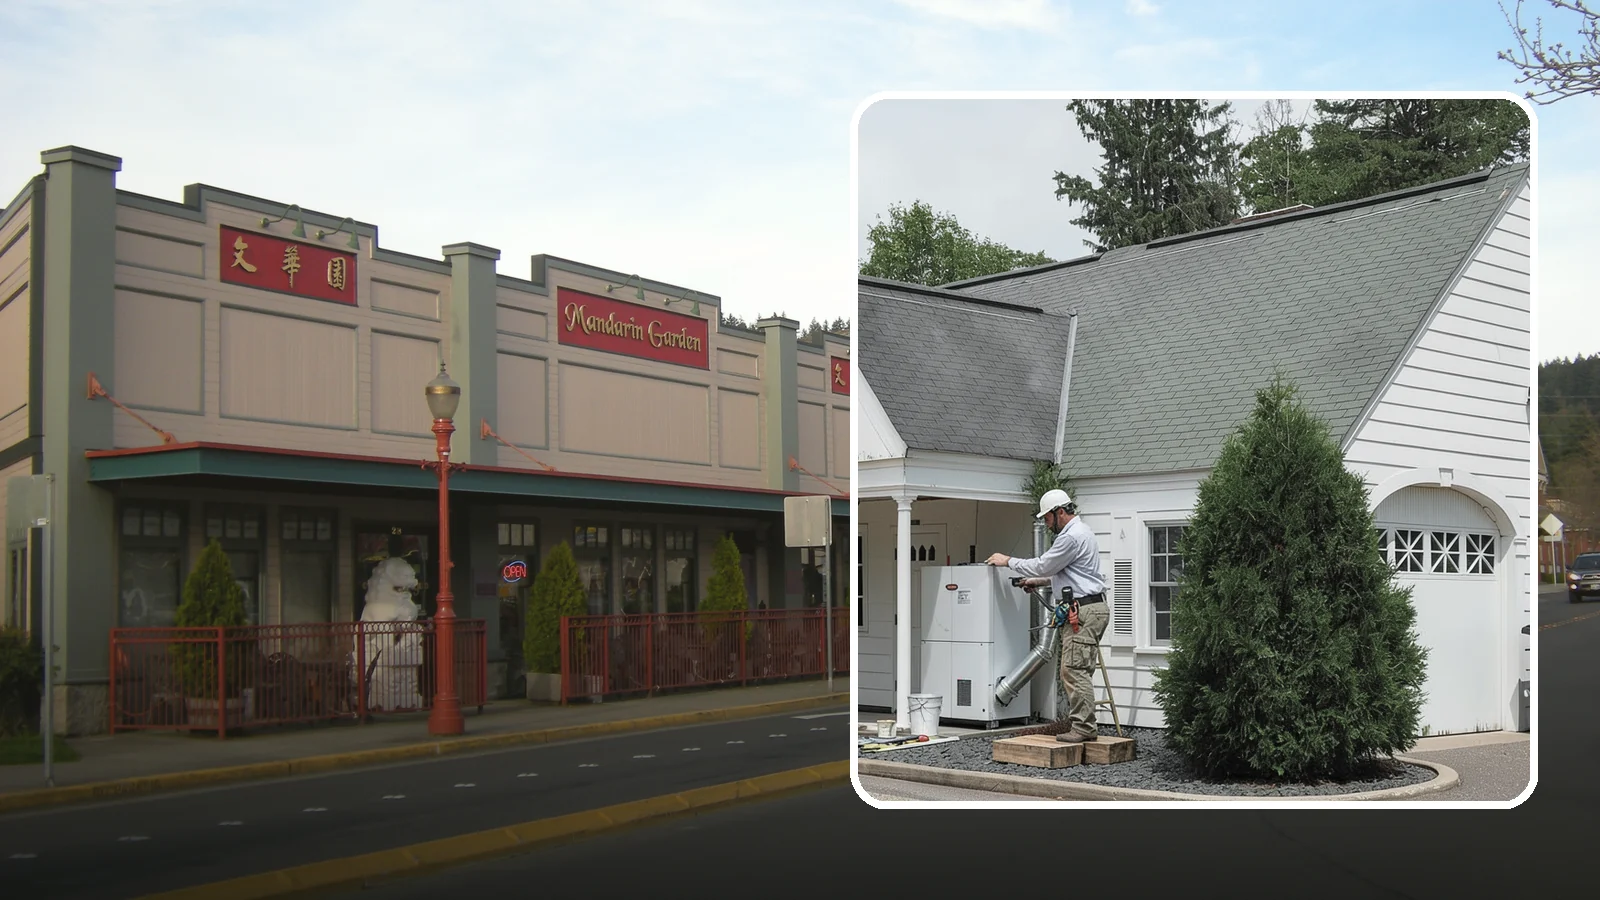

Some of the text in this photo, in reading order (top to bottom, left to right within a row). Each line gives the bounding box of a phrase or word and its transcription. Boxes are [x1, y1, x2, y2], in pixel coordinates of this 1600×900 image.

[564, 302, 702, 352] Mandarin Garden
[503, 565, 527, 578] OPEN
